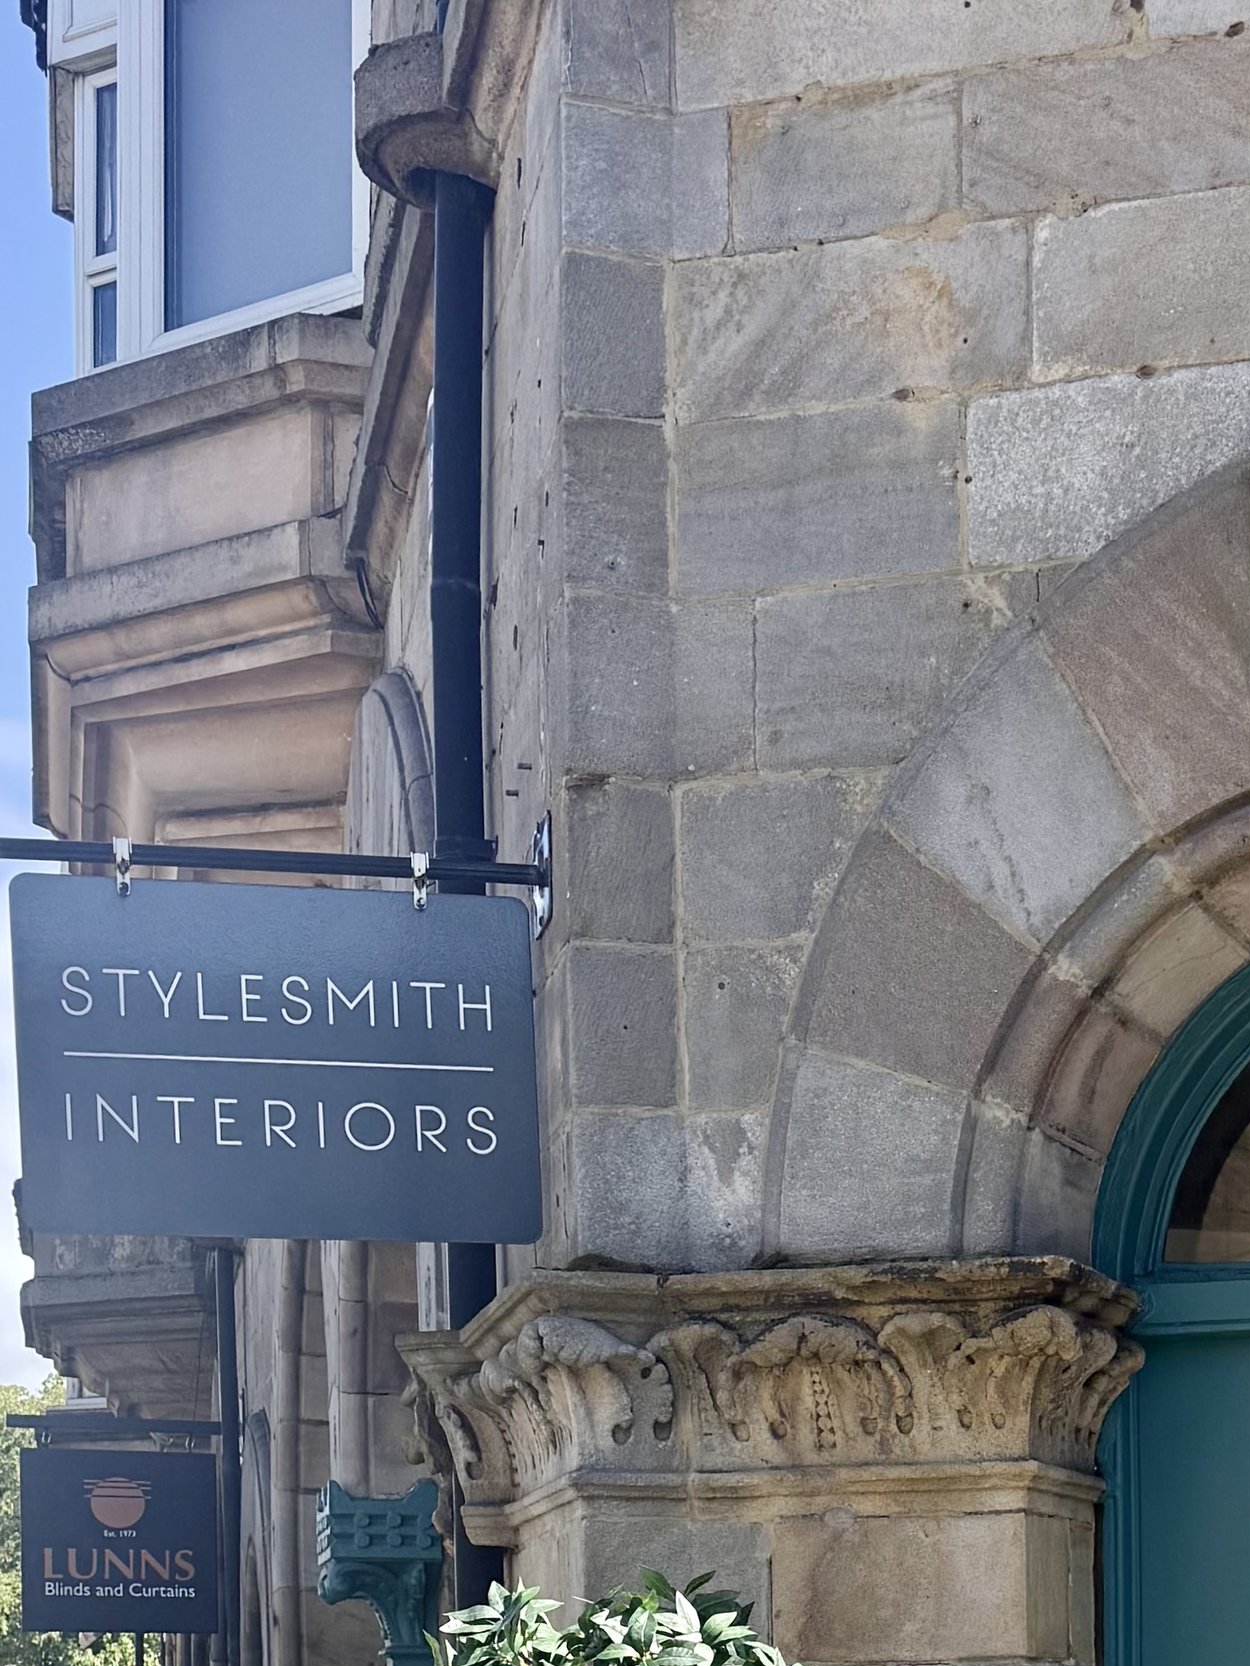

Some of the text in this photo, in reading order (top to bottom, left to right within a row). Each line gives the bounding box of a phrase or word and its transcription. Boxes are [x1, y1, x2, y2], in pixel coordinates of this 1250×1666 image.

[61, 966, 493, 1031] STYLESMITH
[65, 1093, 498, 1155] INTERIORS
[119, 1529, 137, 1538] 1973
[43, 1547, 196, 1581] LUNNS
[44, 1581, 196, 1598] Blinds and Curtains
